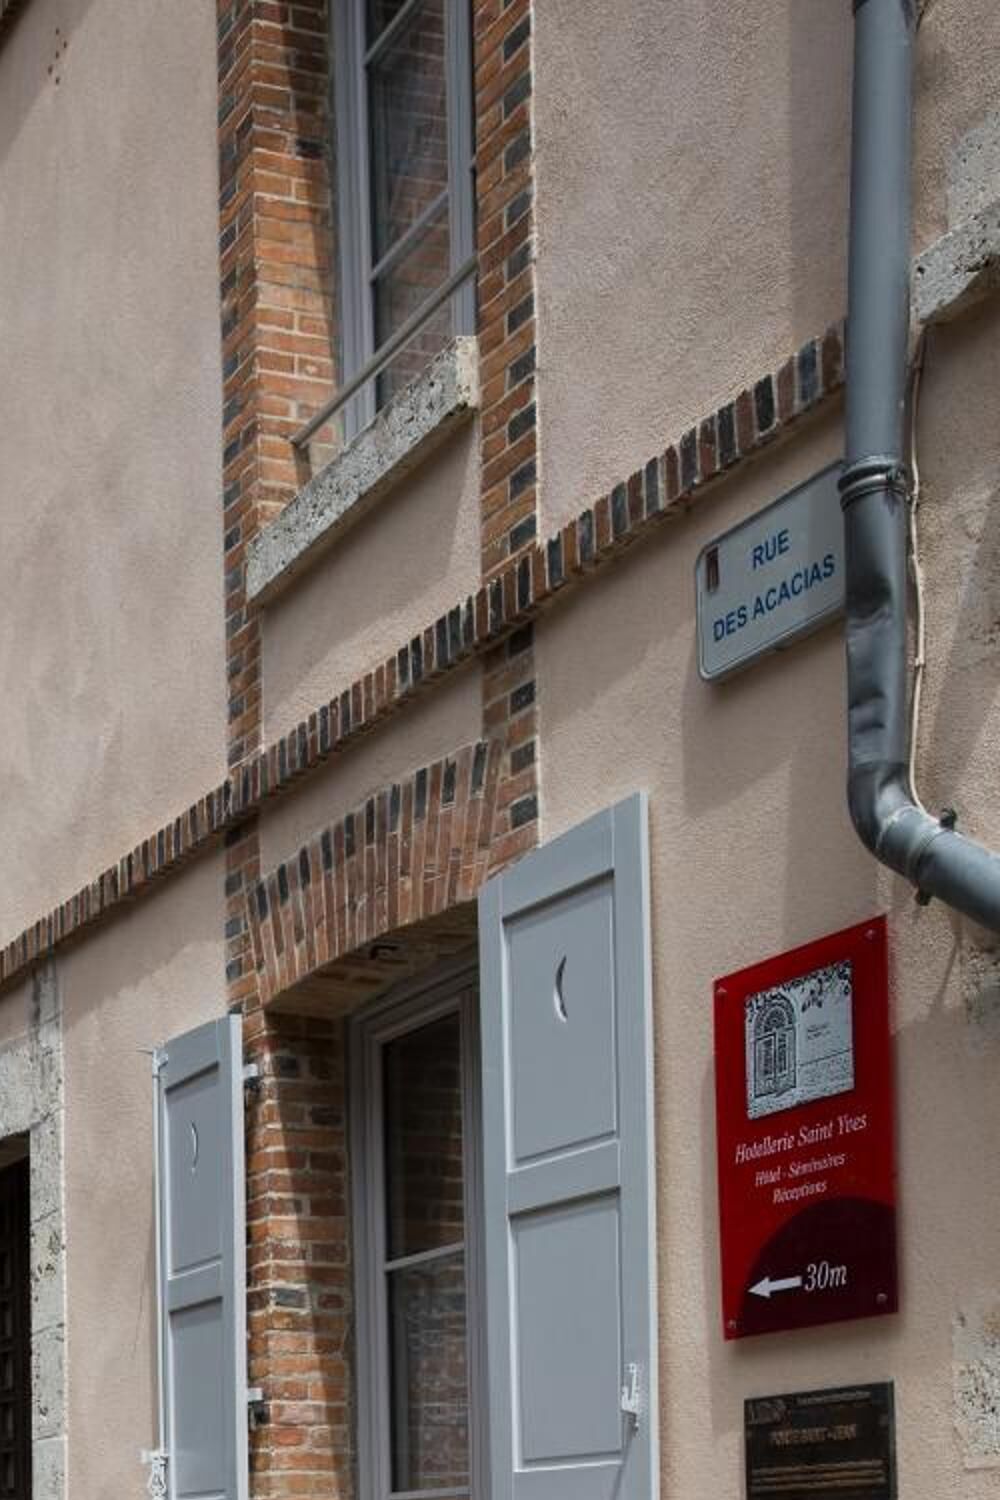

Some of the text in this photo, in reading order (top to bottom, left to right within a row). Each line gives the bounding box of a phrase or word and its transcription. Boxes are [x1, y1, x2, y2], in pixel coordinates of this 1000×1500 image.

[751, 528, 790, 571] RUE
[713, 553, 835, 642] DES ACACIAS
[797, 1121, 833, 1146] Saint
[837, 1113, 867, 1135] Yves
[804, 1260, 848, 1292] 30m
